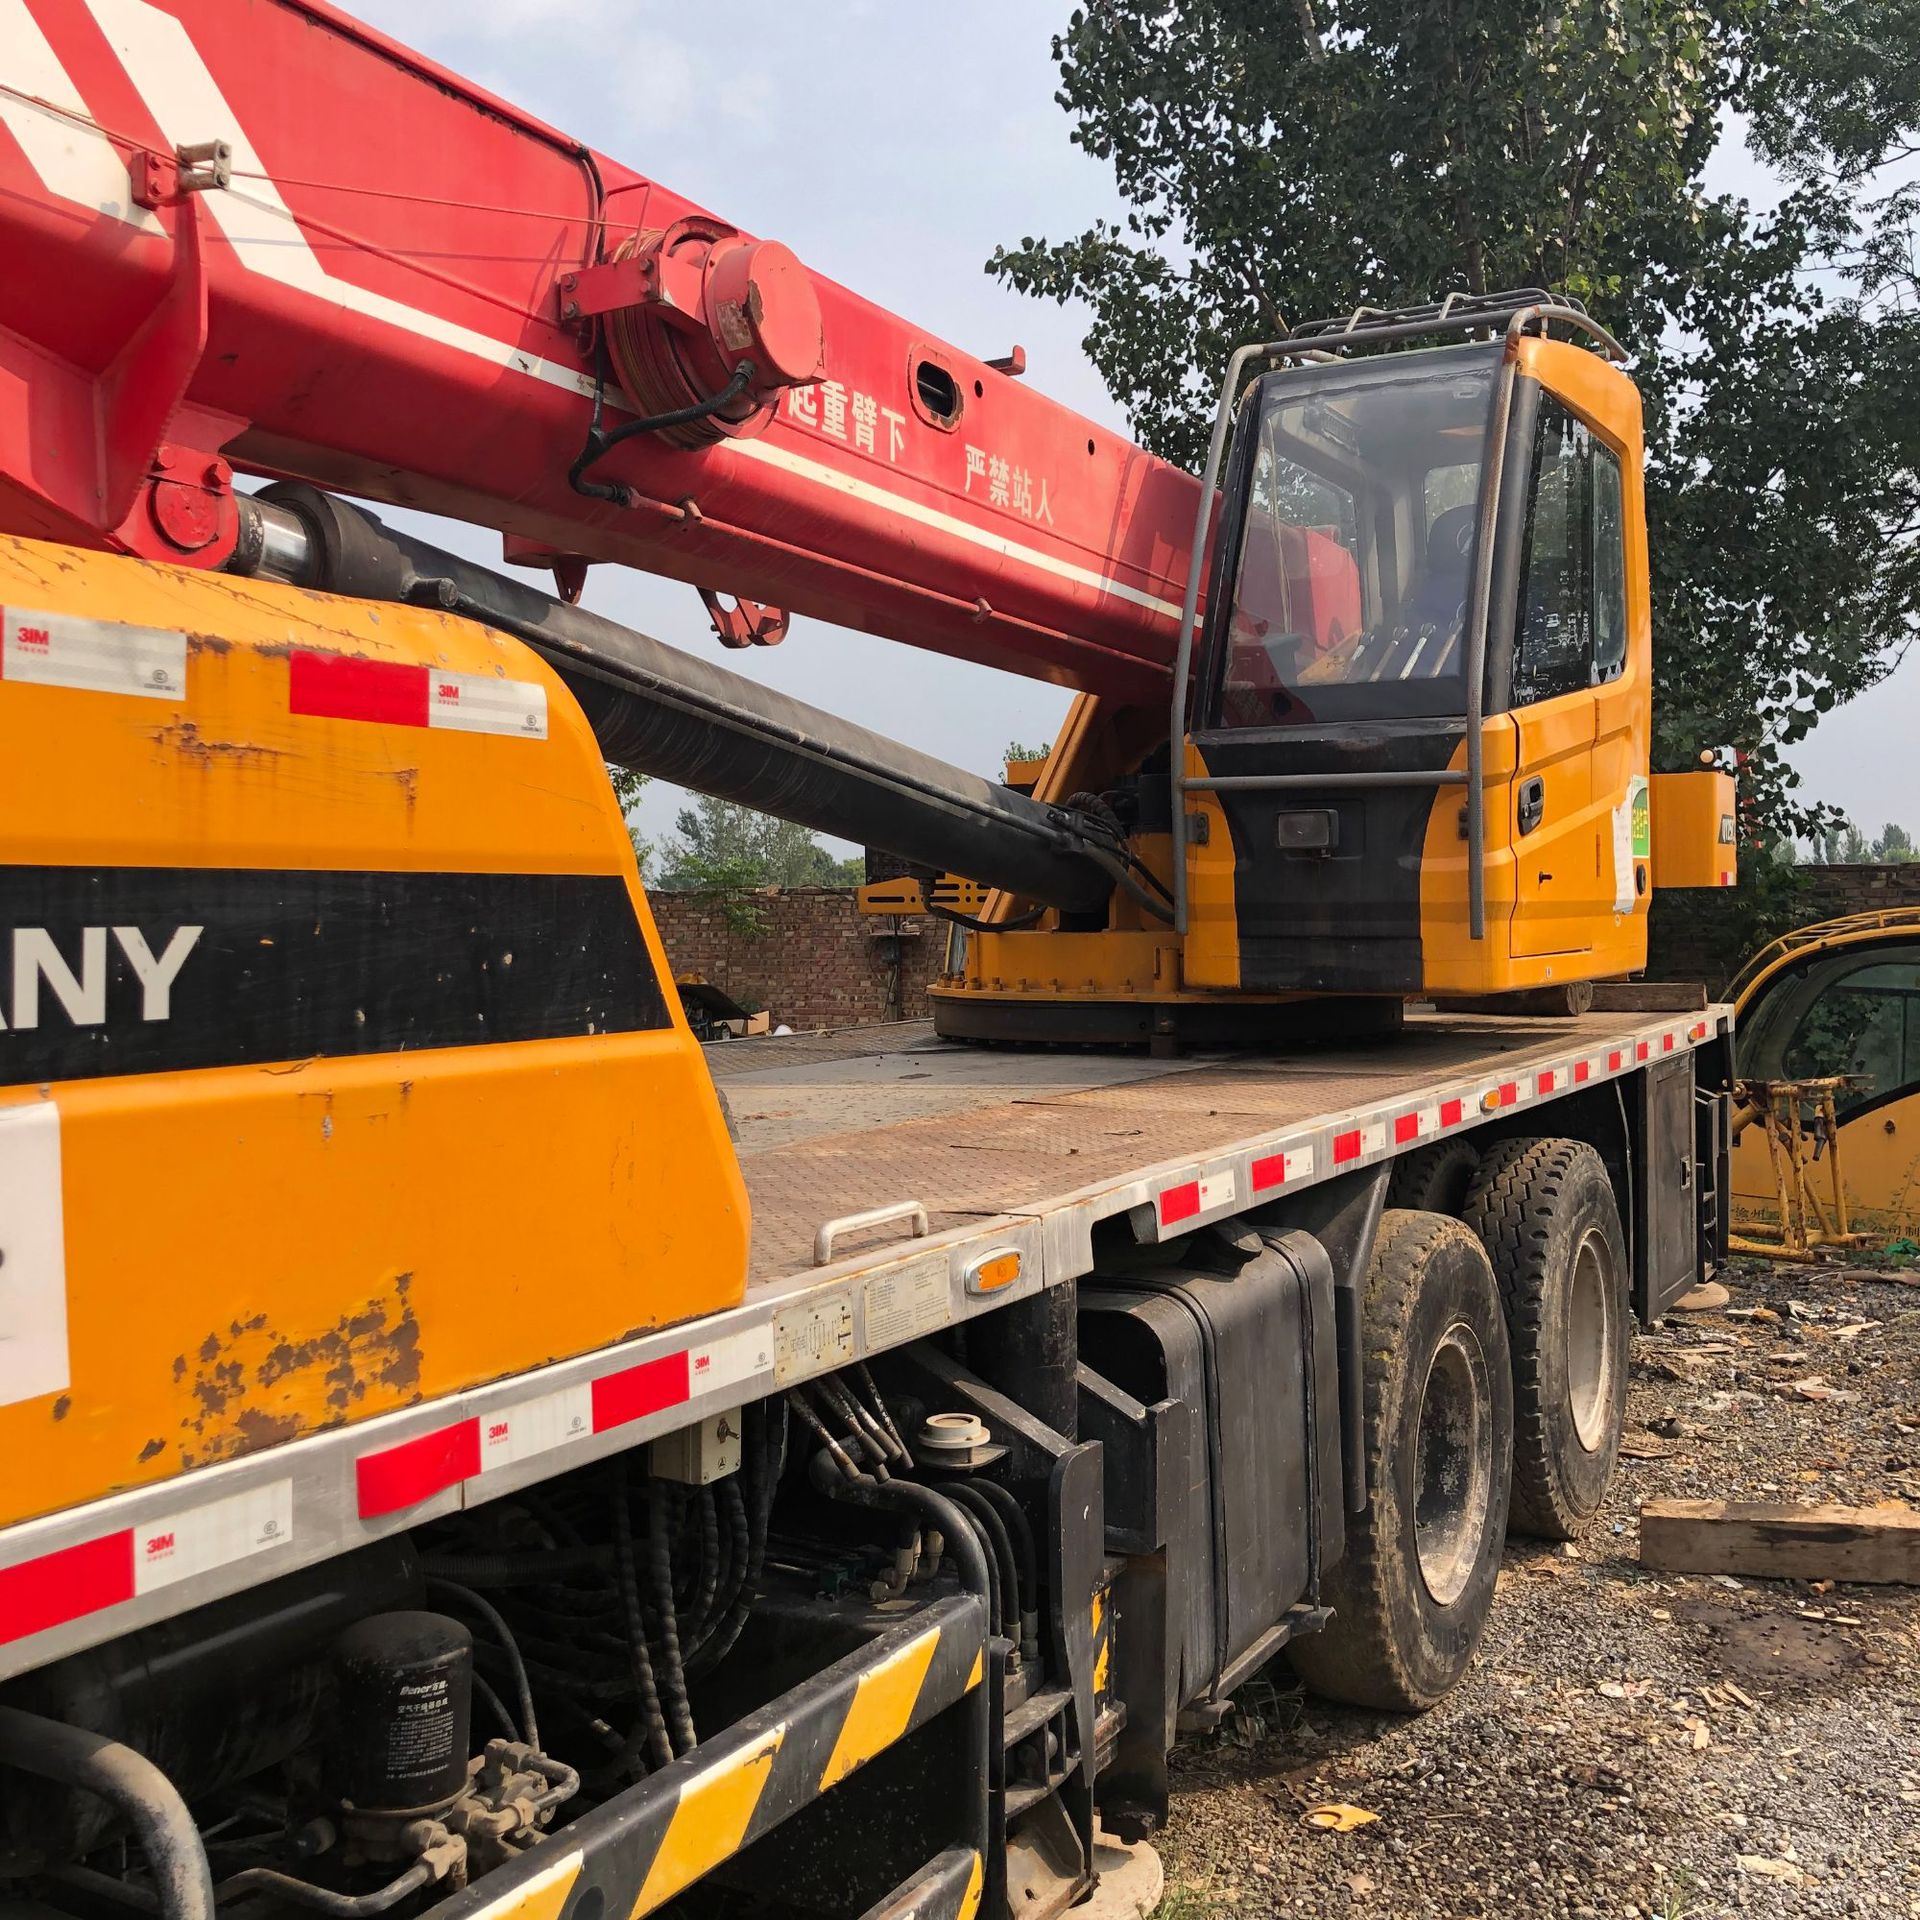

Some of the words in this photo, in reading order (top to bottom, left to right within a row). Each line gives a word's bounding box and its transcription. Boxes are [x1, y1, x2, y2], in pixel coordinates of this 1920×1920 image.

[788, 379, 906, 462] 起重臂下
[965, 443, 1054, 528] 严禁站人
[18, 627, 48, 645] 3M
[438, 684, 459, 699] 3M
[0, 926, 205, 1030] NY
[694, 1355, 710, 1369] 3M
[488, 1422, 508, 1439] 3M
[147, 1532, 174, 1554] 3M
